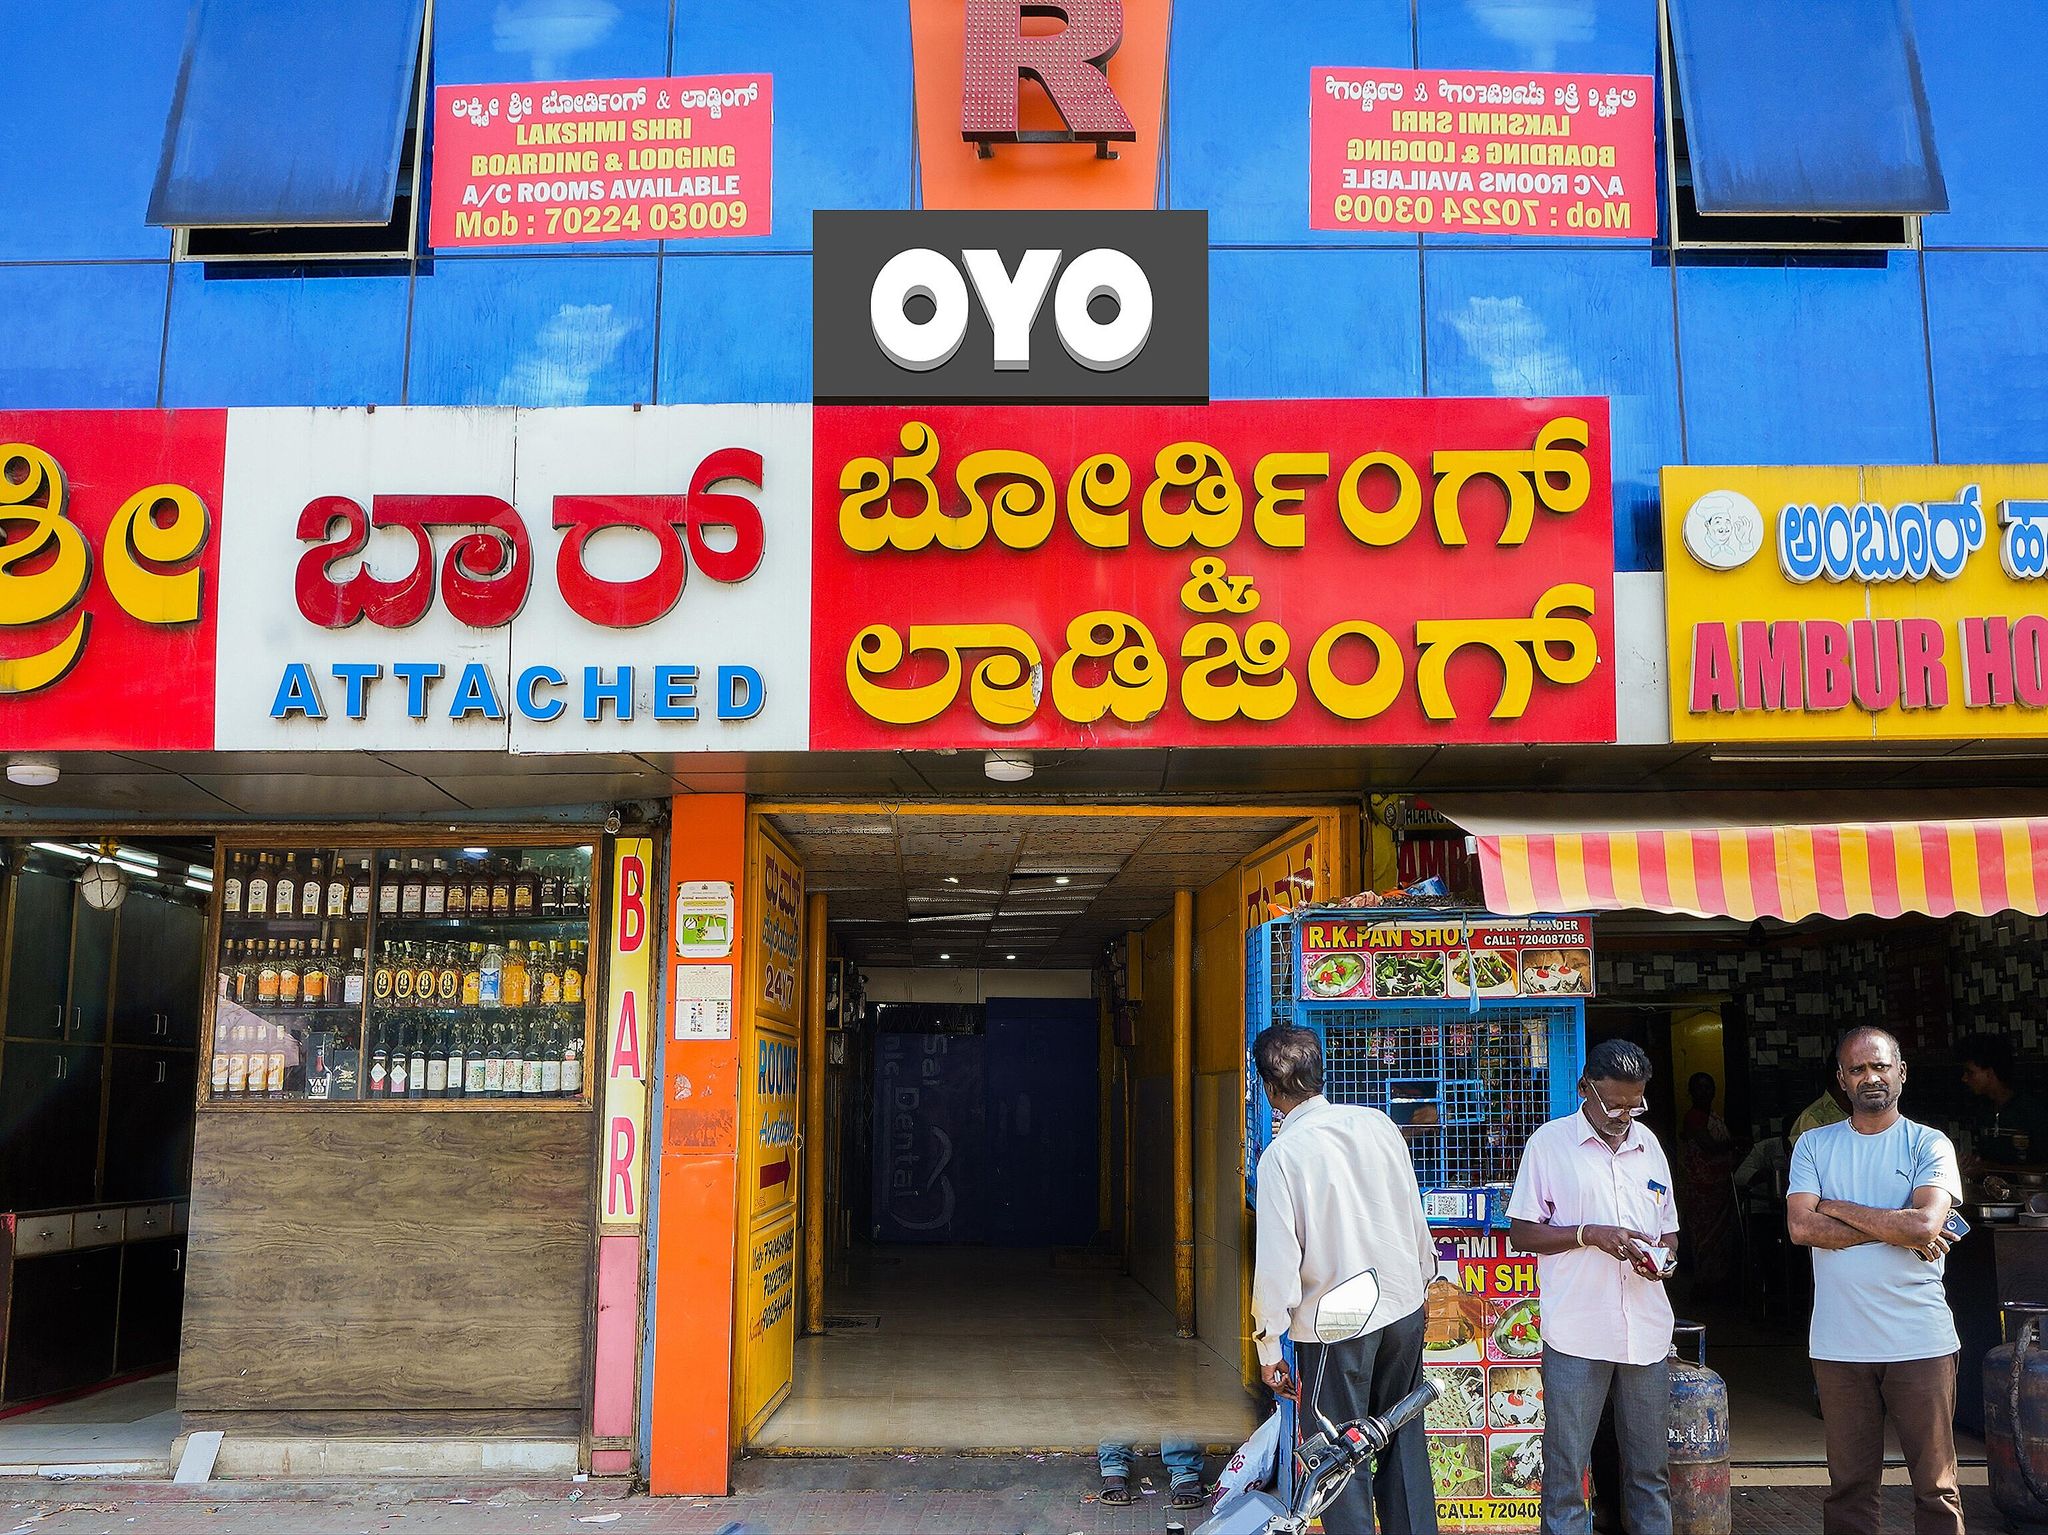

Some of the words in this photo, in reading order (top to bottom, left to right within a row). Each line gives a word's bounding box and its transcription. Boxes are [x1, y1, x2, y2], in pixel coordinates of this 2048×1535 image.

[962, 0, 1136, 142] R
[506, 92, 533, 123] ಶ್ರೀ
[541, 87, 646, 115] ಬೋರ್ಡಿಂಗ್
[656, 91, 671, 109] &
[516, 120, 626, 145] LAKSHMI
[632, 118, 692, 140] SHRI
[471, 152, 598, 177] BOARDING
[604, 152, 623, 172] &
[628, 146, 736, 170] LODGING
[455, 210, 518, 238] Mob
[545, 204, 641, 235] 70224
[649, 201, 747, 231] 03009
[462, 183, 512, 207] A/C
[517, 180, 604, 203] ROOMS
[610, 176, 740, 199] AVAILABLE
[870, 247, 1154, 372] OYO
[838, 416, 1592, 553] ಬೋರ್ಡಿಂಗ್
[295, 447, 766, 629] ಬಾರ್
[1777, 484, 1986, 583] ಅಂಬೂರ್
[1180, 556, 1261, 614] &
[269, 662, 767, 722] ATTACHED
[1690, 618, 1949, 713] AMBUR
[1410, 929, 1475, 948] SHOP
[1484, 936, 1516, 946] CALL:
[1519, 934, 1585, 945] 7204087056
[607, 855, 646, 1216] BAR
[757, 1039, 798, 1101] ROOMS
[894, 1087, 920, 1198] Dental
[1495, 1264, 1540, 1292] SH
[1437, 1503, 1483, 1519] CALL:
